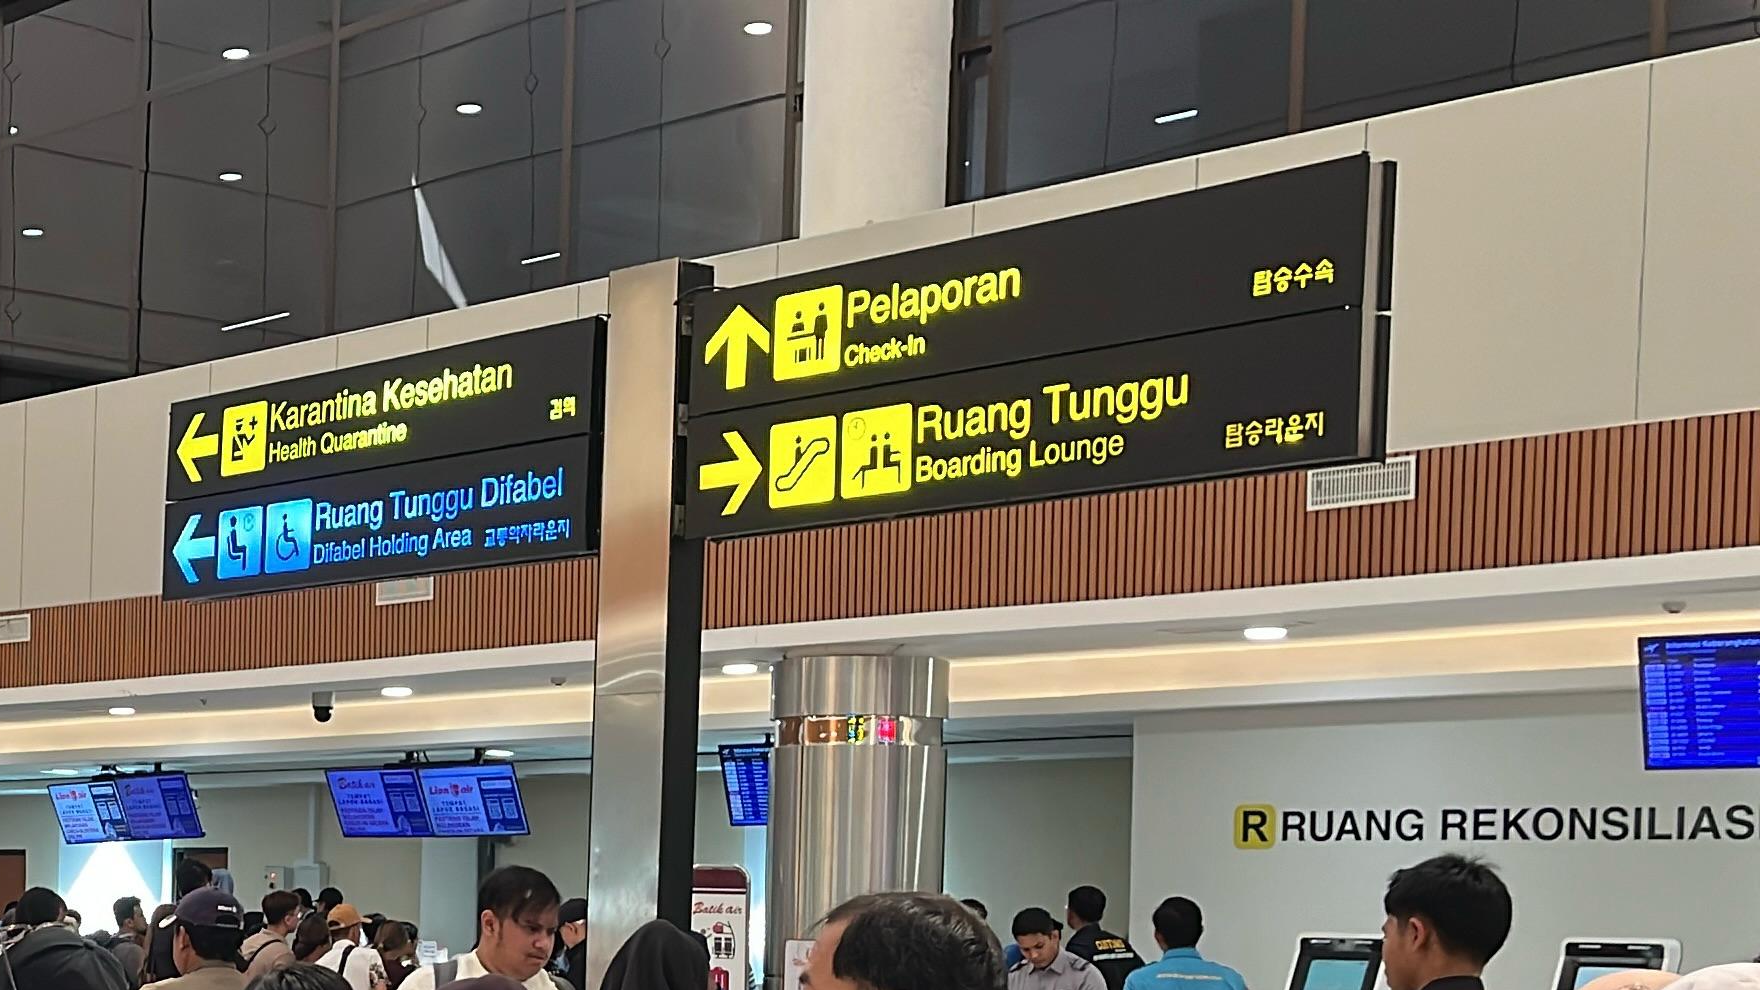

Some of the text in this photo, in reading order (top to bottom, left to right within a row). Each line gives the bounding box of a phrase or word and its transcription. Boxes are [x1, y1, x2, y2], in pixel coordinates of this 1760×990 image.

[846, 267, 1021, 329] Pelaporan
[1252, 259, 1334, 297] 탑승수속
[843, 334, 926, 367] Check-In
[269, 363, 513, 432] Karantina Kesehatan
[917, 373, 1189, 444] Ruang Tunggu
[268, 421, 408, 463] Health Quarantine
[1225, 411, 1324, 449] 탑승라운지
[915, 434, 1125, 483] Boarding Lounge
[314, 466, 564, 531] Ruang Tunggu Difabel
[313, 526, 472, 565] Difabel Holding Area
[1242, 804, 1760, 843] R RUANG REKONSILIAS
[693, 901, 743, 914] Batik air
